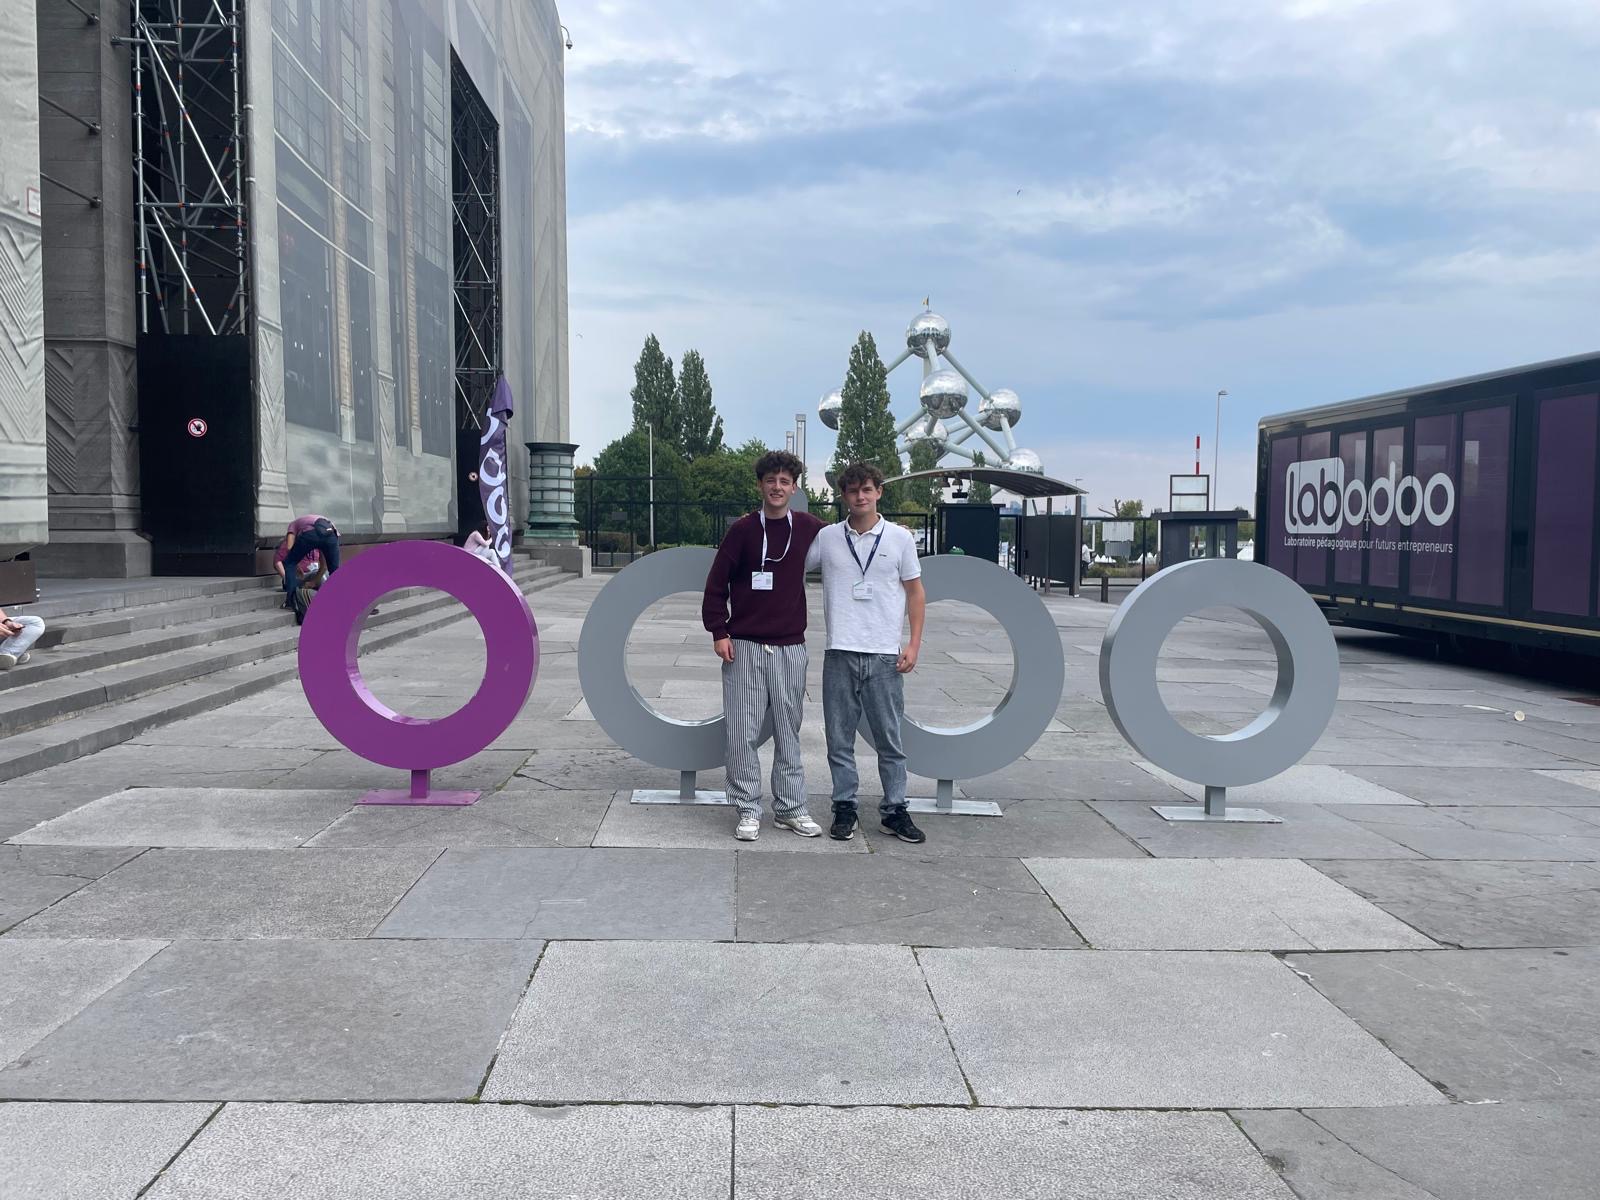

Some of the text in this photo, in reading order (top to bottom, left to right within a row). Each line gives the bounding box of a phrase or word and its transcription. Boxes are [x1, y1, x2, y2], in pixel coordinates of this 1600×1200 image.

[1286, 459, 1455, 530] labodoo
[1284, 536, 1453, 554] Laboratoire pédagogique pour futurs entrepreneurs
